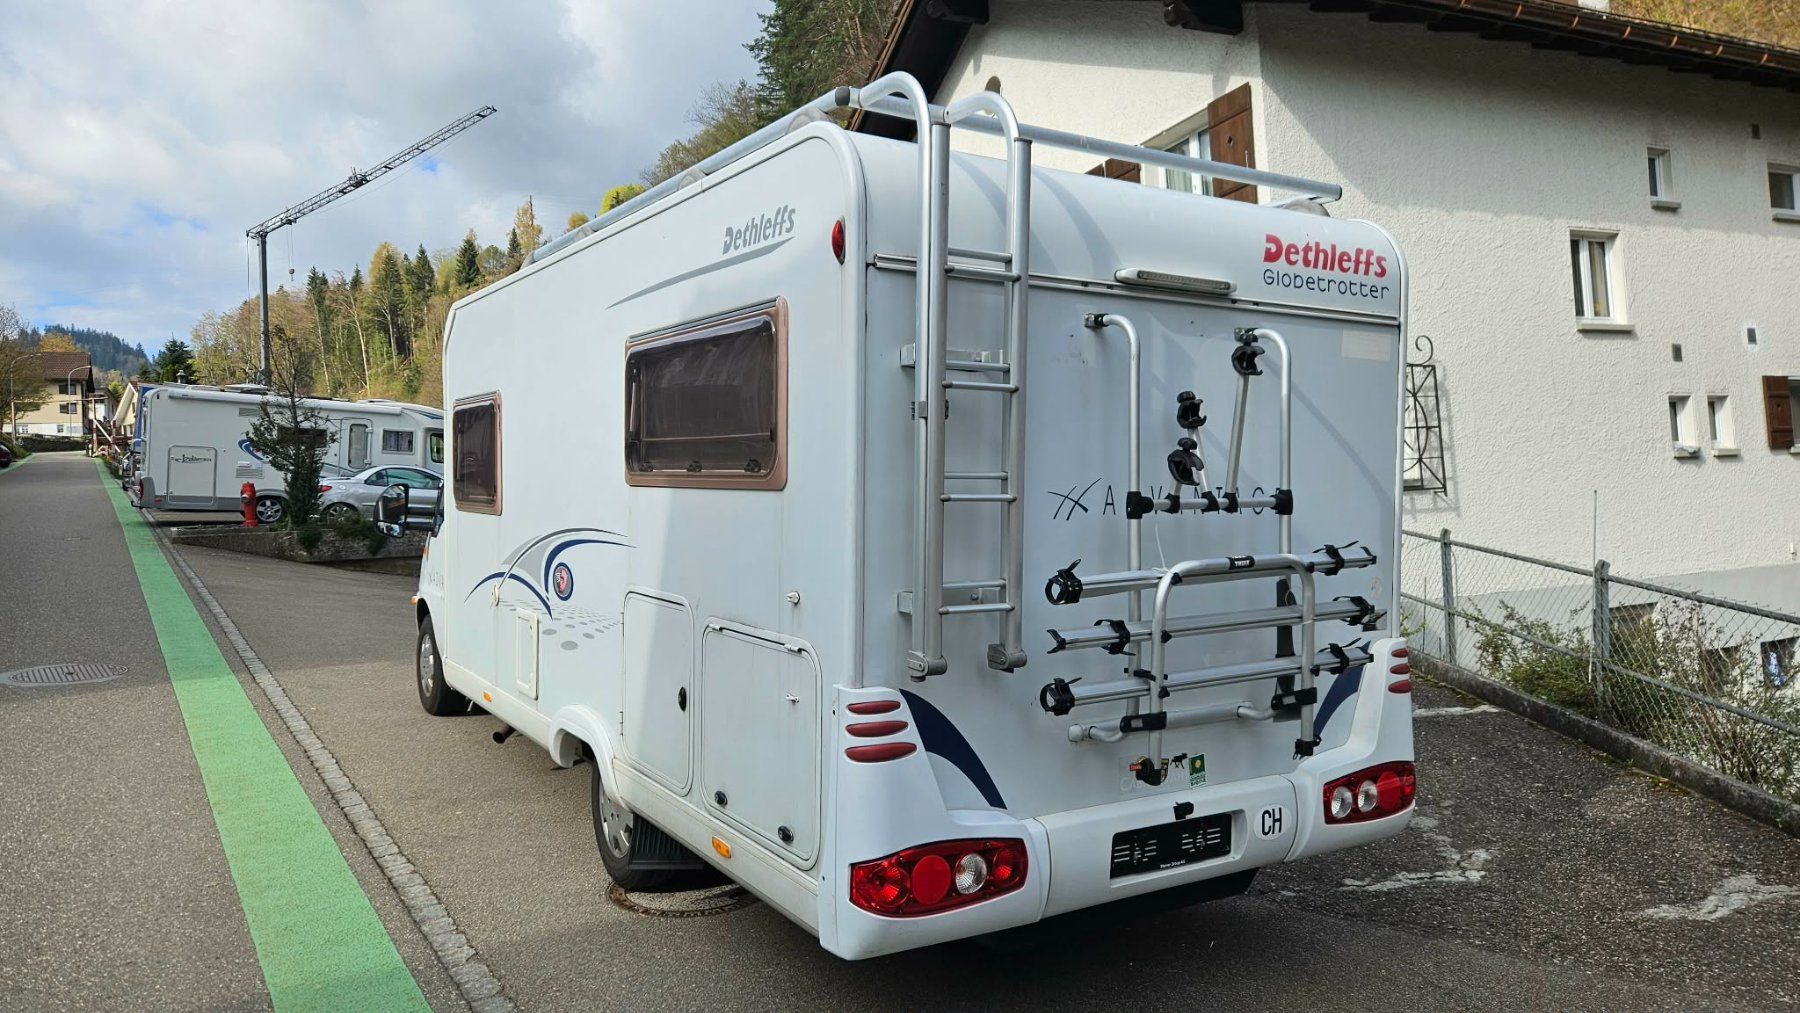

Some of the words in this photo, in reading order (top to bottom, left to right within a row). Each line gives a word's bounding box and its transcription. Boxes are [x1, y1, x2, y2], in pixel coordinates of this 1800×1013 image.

[722, 204, 796, 255] Dethleffs
[1263, 234, 1386, 278] Dethleffs
[1263, 268, 1389, 298] Globetrotter
[1261, 807, 1282, 836] CH
